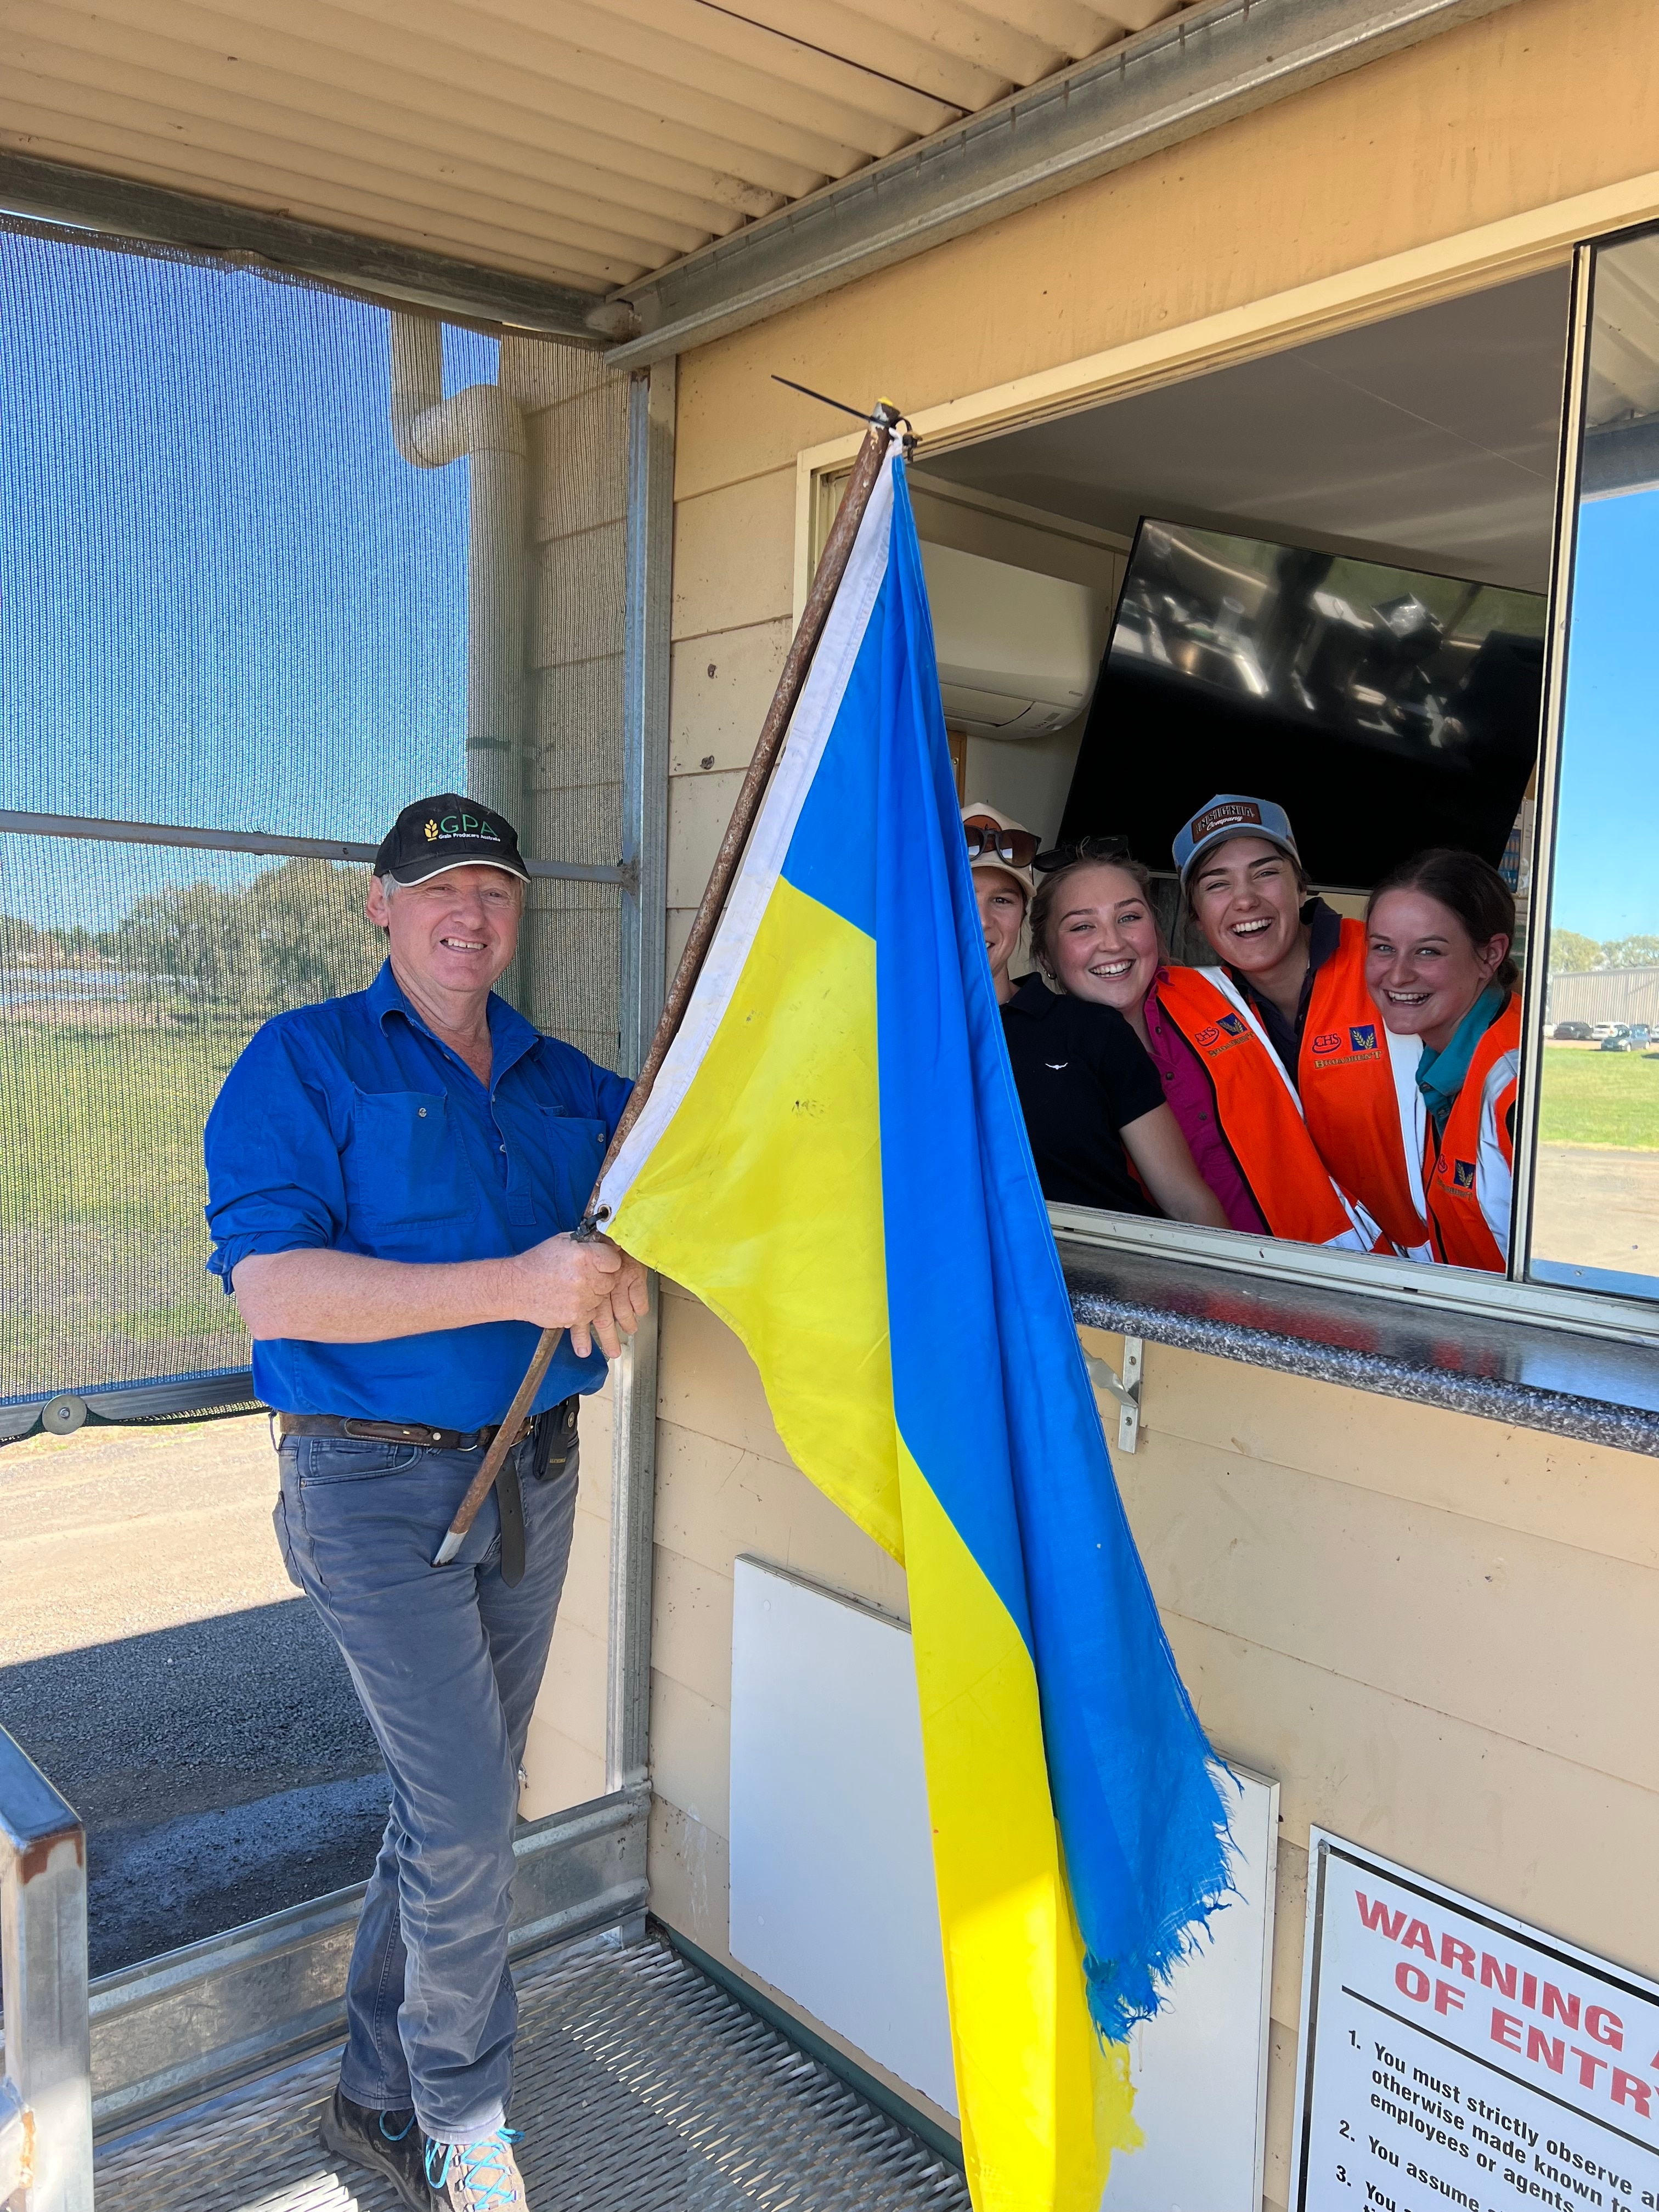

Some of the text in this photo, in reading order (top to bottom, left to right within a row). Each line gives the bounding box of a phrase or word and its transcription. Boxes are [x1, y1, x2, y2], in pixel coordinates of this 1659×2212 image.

[441, 814, 498, 837] GPA
[1197, 805, 1255, 833] INSIGNIA
[1206, 816, 1243, 831] Company
[1194, 1026, 1217, 1042] CHS
[1314, 1033, 1340, 1047] CHS
[1314, 1050, 1382, 1069] BROADBENT
[1355, 1889, 1624, 2052] WARNING
[1395, 1962, 1659, 2120] OF ENTR
[1348, 2030, 1361, 2050] 1.
[1374, 2041, 1406, 2074] You
[1413, 2067, 1460, 2104] must
[1466, 2097, 1539, 2147] strictly
[1547, 2140, 1632, 2195] observe
[1370, 2094, 1575, 2212] employees or agents
[1372, 2070, 1465, 2130] otherwise
[1472, 2124, 1526, 2164] made
[1534, 2154, 1602, 2207] known
[1336, 2165, 1396, 2212] 3. You
[1339, 2119, 1479, 2212] 2. You assume
